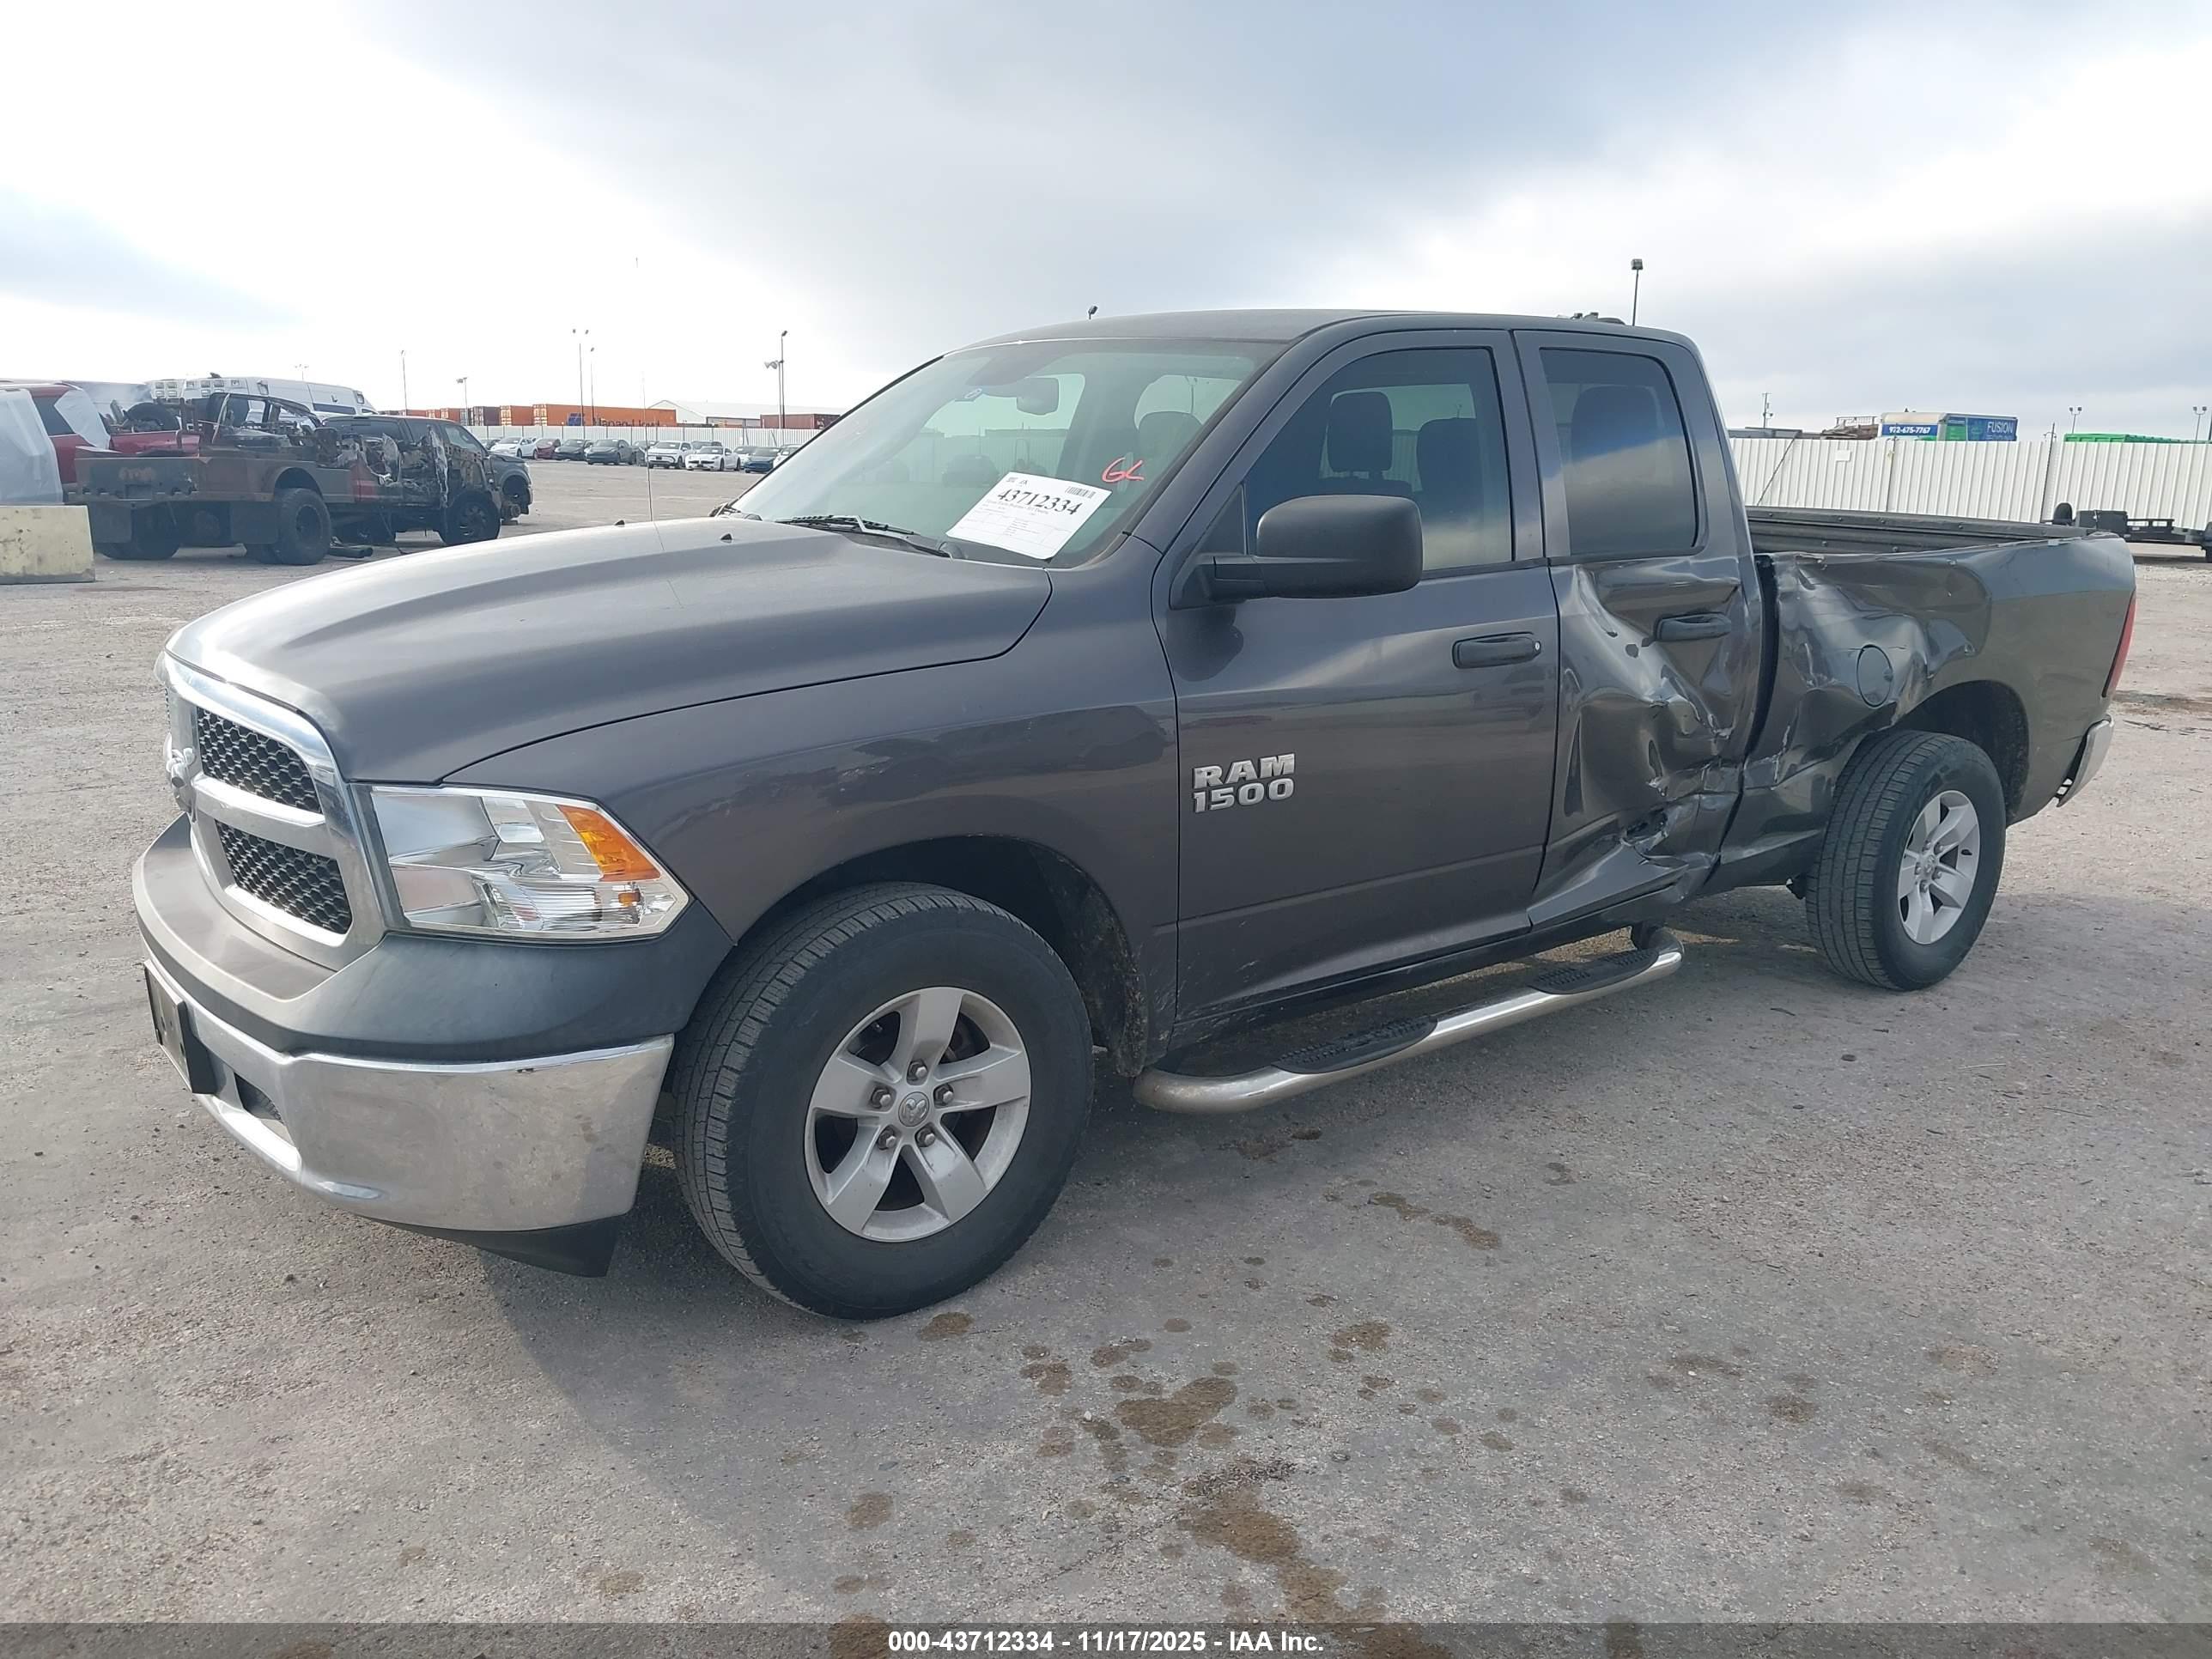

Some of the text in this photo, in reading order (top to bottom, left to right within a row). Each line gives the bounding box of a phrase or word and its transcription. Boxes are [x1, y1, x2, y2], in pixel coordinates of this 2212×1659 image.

[1987, 422, 2014, 434] FUSION
[998, 489, 1083, 514] 43712334
[1194, 753, 1295, 788] RAM
[1194, 778, 1294, 813] 1500
